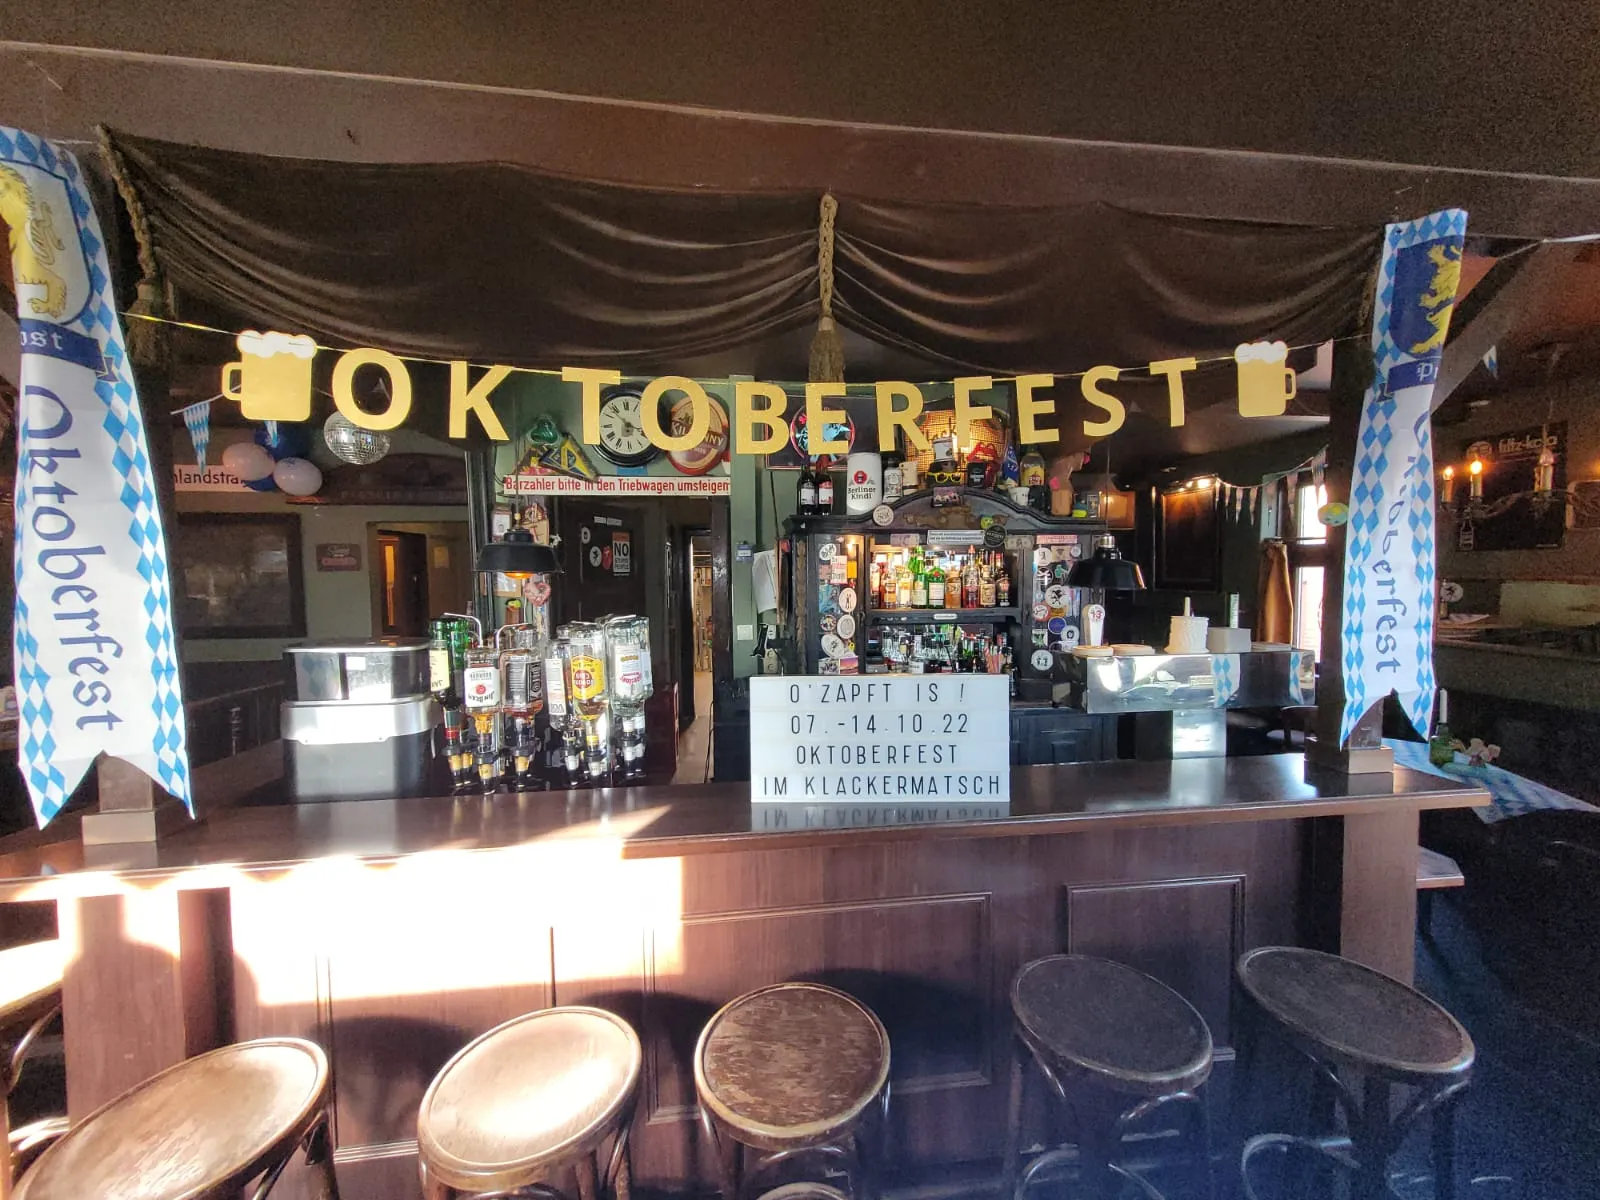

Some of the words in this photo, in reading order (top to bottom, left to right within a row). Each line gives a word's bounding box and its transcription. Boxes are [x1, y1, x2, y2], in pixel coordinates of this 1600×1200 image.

[332, 348, 1197, 455] OKTOBERFEST
[505, 477, 555, 491] Barzahler
[558, 478, 581, 491] bitte
[584, 480, 594, 491] in
[597, 478, 615, 491] den
[618, 479, 674, 494] Triebwagen
[677, 480, 729, 494] umsteigen
[848, 486, 876, 494] Berliner
[25, 385, 124, 731] Oktoberfest
[615, 543, 629, 556] NO
[790, 683, 891, 703] O'ZAPFT
[916, 683, 938, 703] IS
[796, 744, 958, 765] OKTOBERFEST
[764, 776, 788, 796] IM
[805, 775, 1000, 796] KLACKERMATSCH
